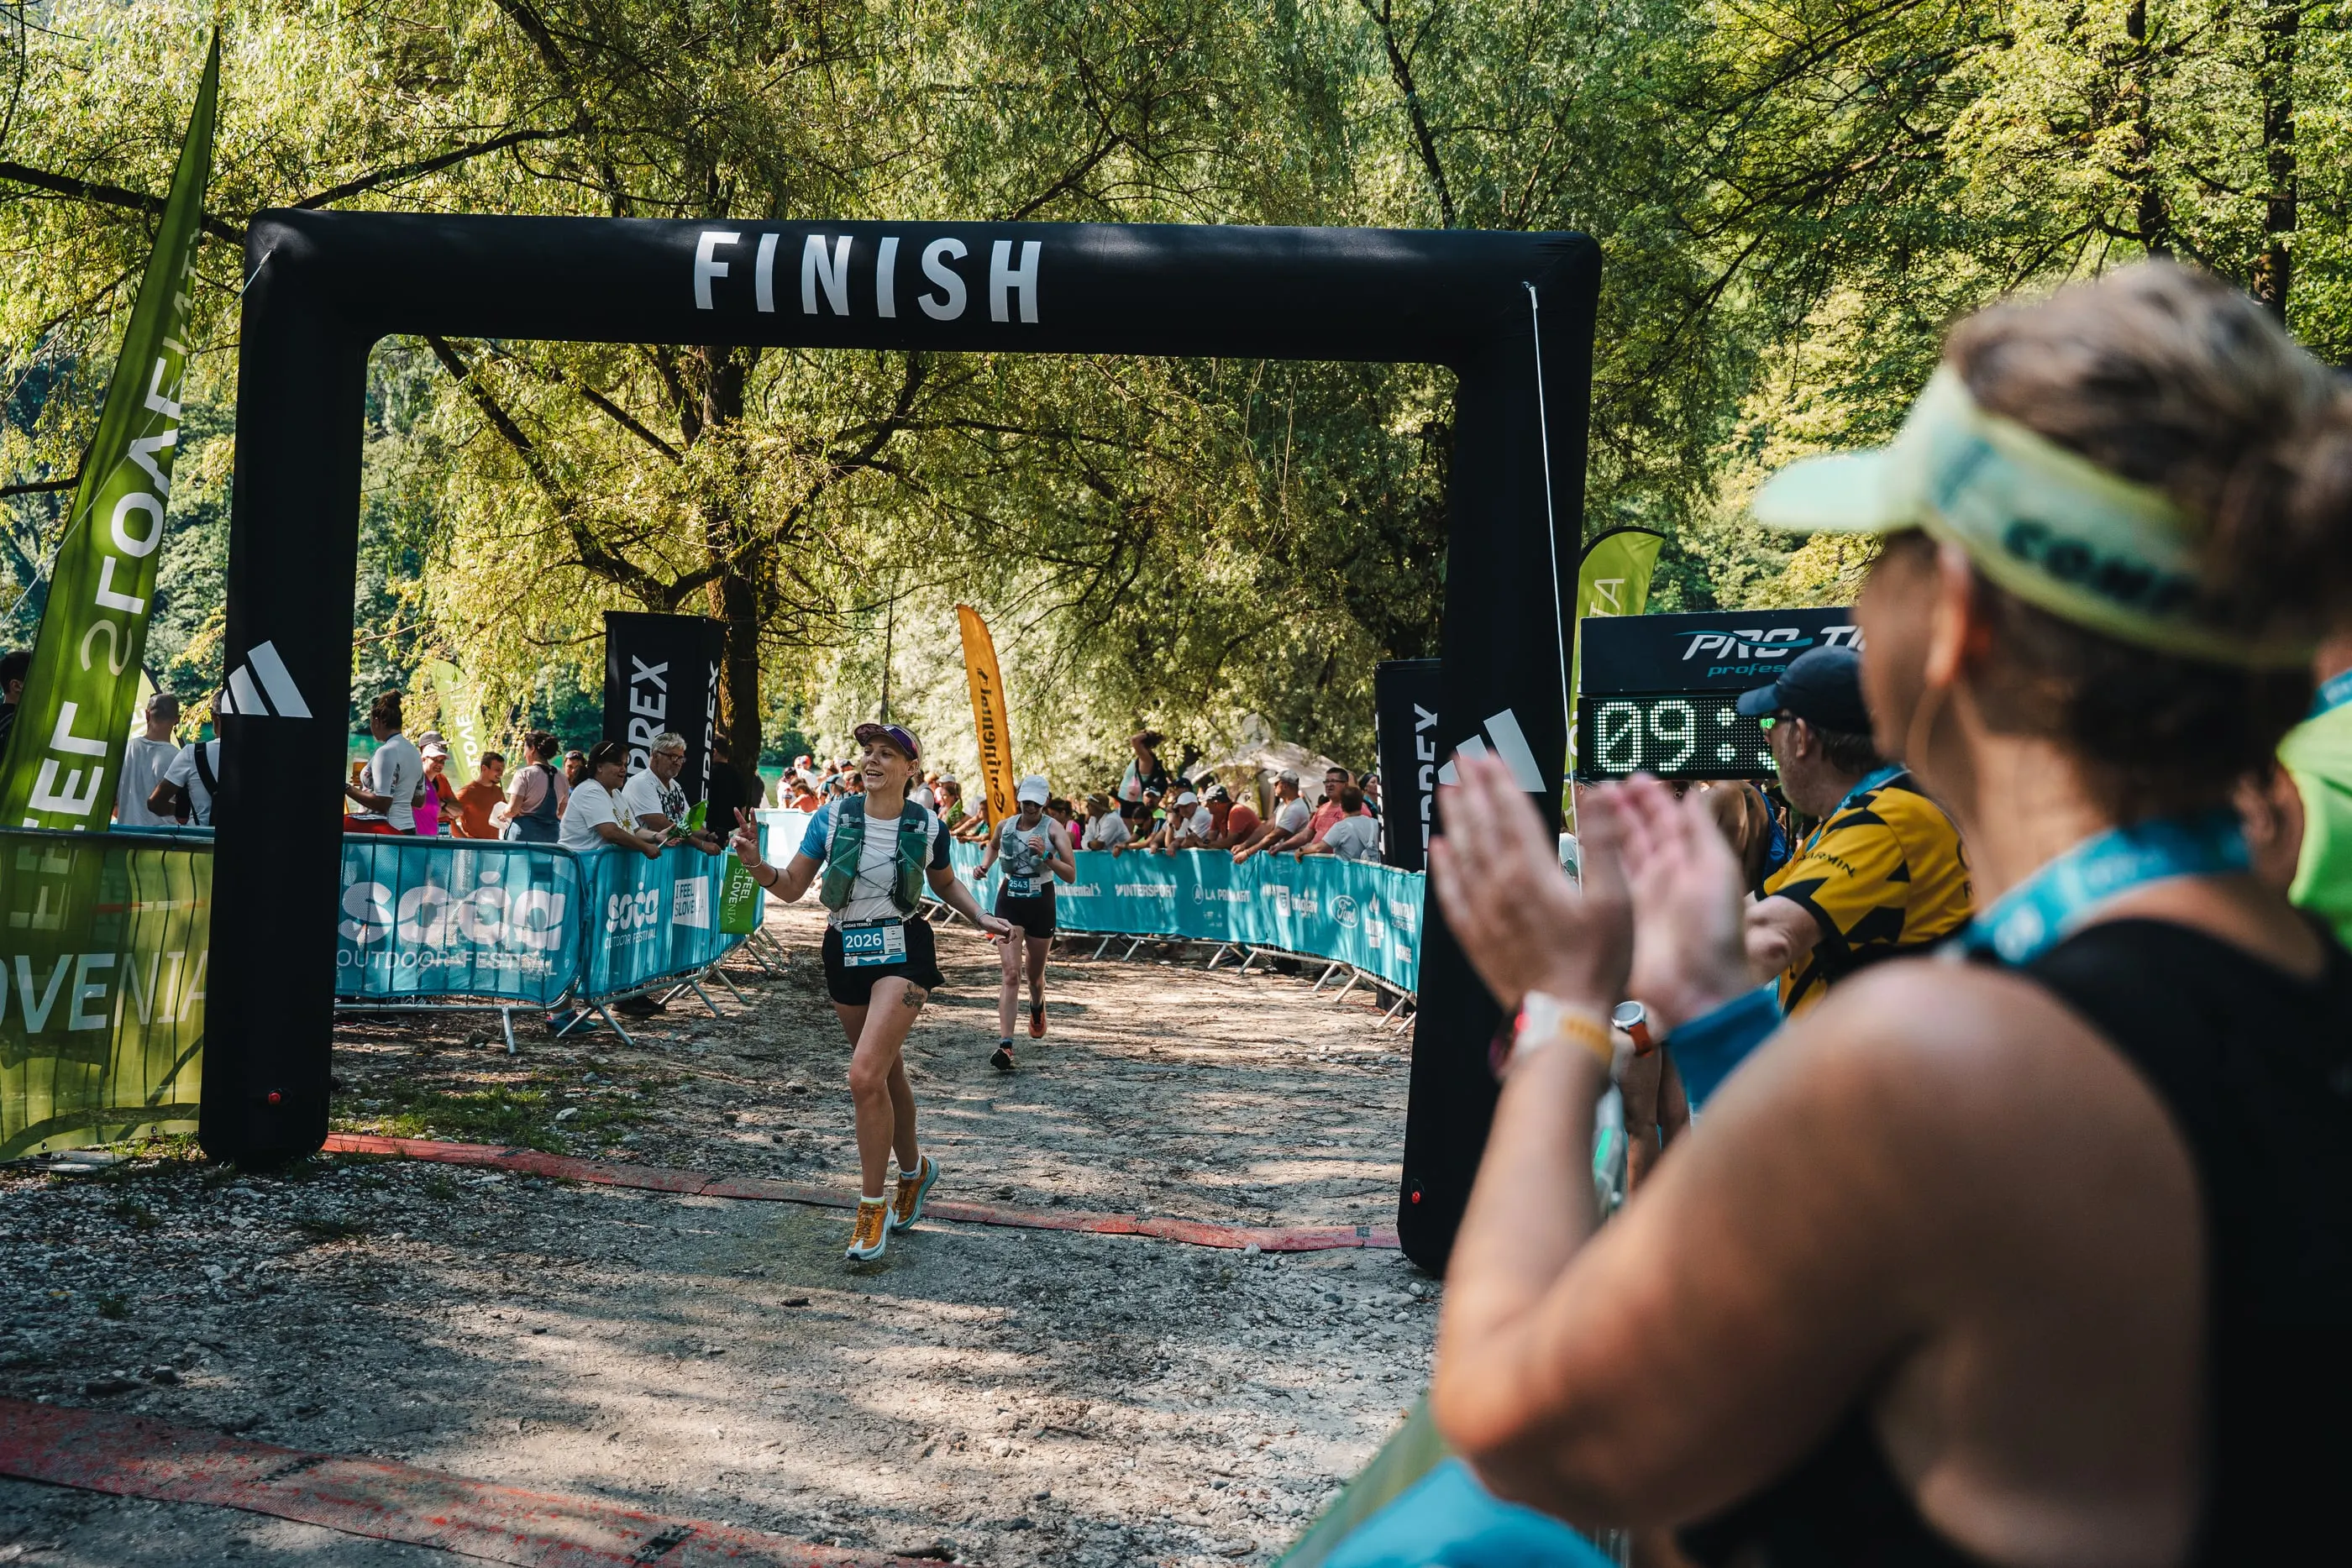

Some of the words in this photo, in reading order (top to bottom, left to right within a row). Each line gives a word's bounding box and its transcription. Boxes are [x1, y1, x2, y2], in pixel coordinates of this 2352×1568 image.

[693, 231, 1042, 324] FINISH
[1682, 628, 1800, 660] PRO
[1596, 700, 1779, 773] 09:
[680, 883, 694, 899] FEEL
[739, 876, 754, 902] FEEL
[1009, 879, 1028, 889] 2543
[1123, 884, 1178, 898] INTERSPORT
[1205, 889, 1216, 901] LA
[727, 868, 744, 925] SLOVENIA
[1336, 899, 1357, 924] Ford
[633, 928, 657, 944] FESTIVAL
[845, 932, 882, 948] 2026
[337, 949, 451, 971] OUTDOOR
